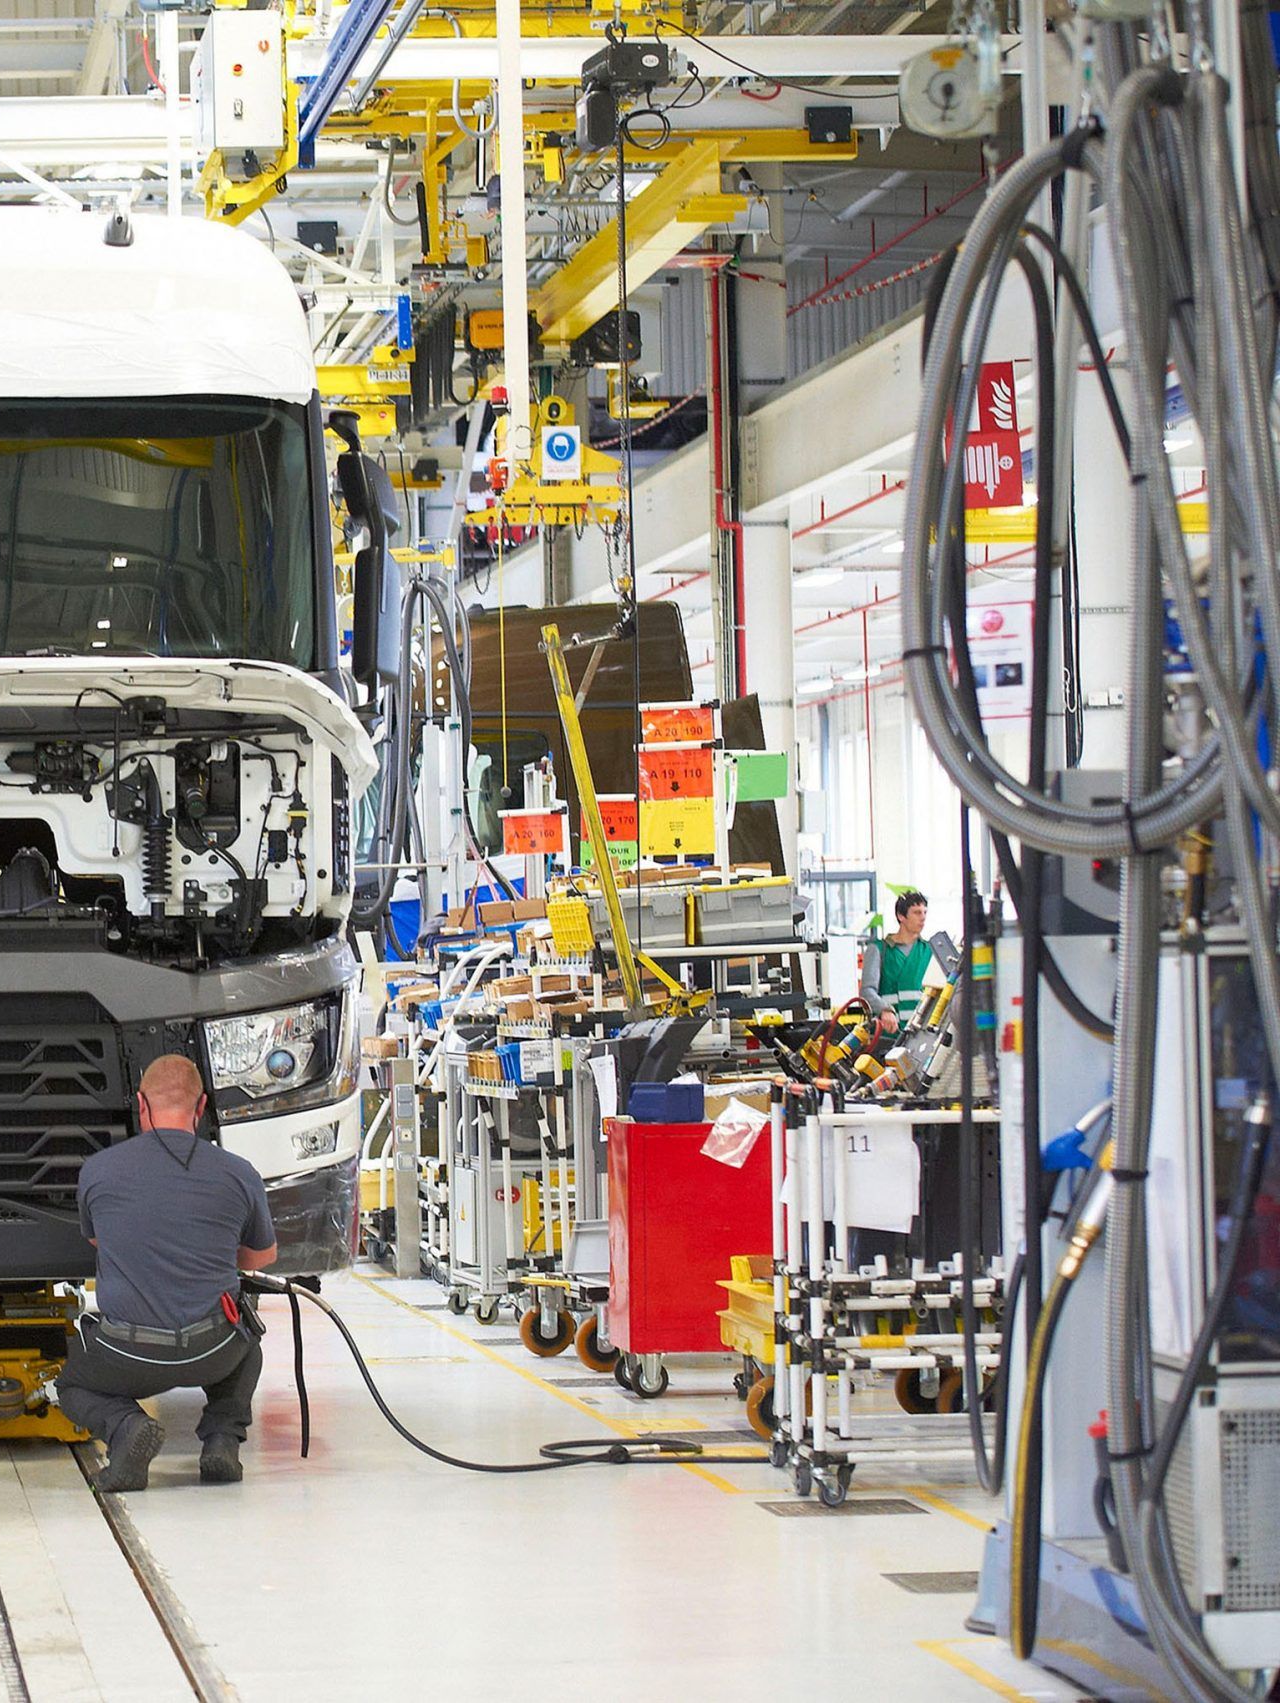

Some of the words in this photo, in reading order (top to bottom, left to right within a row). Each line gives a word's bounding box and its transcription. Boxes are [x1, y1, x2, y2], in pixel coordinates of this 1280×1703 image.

[654, 729, 661, 737] A
[665, 727, 677, 737] 20
[685, 726, 703, 736] 190
[650, 770, 658, 779] A
[662, 768, 675, 779] 19
[683, 768, 702, 778] 110
[618, 816, 635, 825] 170
[523, 830, 533, 838] 20
[847, 1135, 871, 1153] 11
